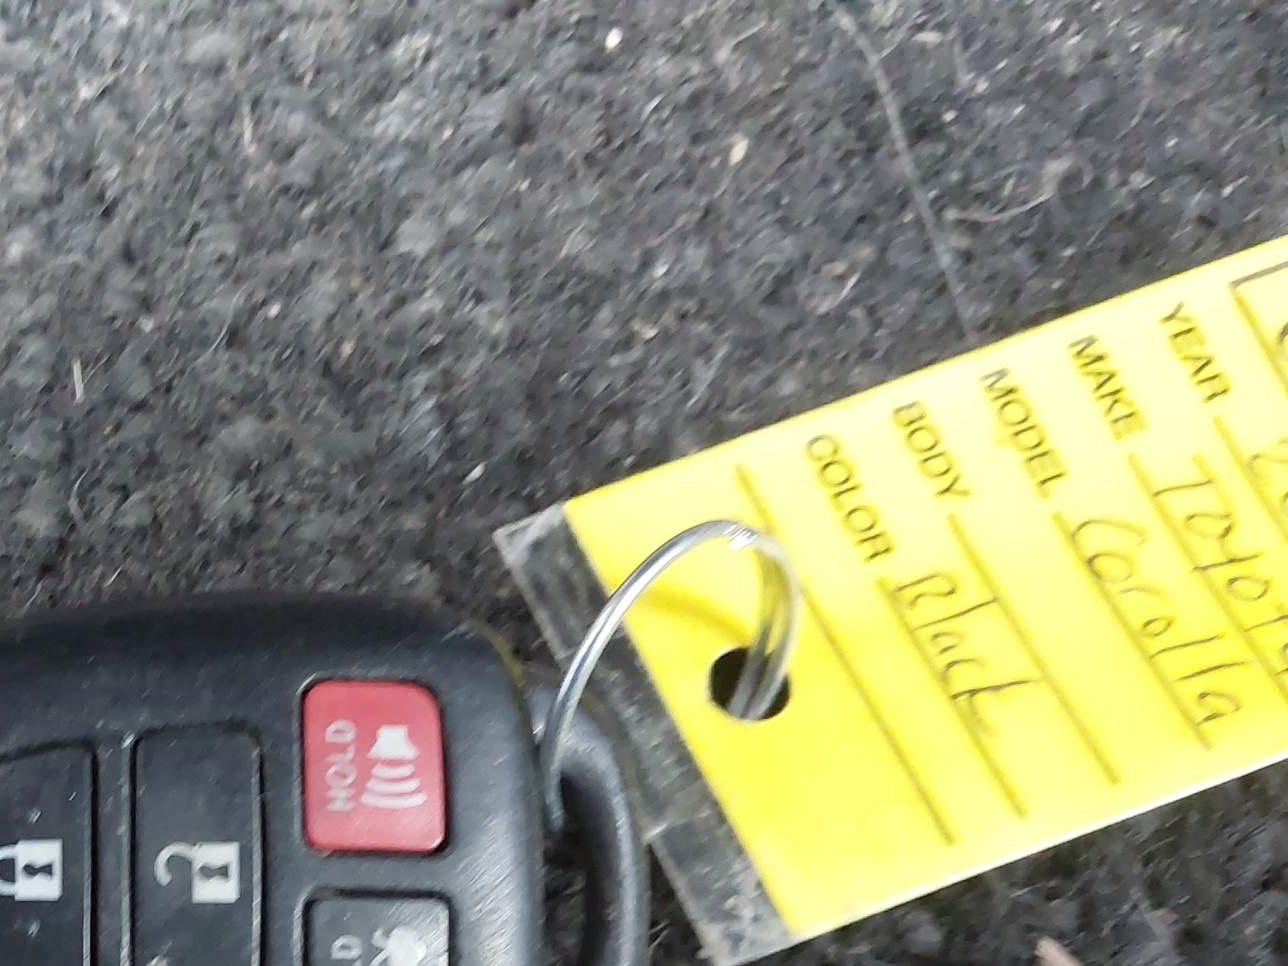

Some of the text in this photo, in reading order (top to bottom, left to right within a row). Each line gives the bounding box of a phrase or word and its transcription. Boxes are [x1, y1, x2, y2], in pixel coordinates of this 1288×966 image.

[1067, 334, 1149, 441] MAKE
[1158, 301, 1231, 405] YEAR
[890, 400, 972, 500] BODY
[978, 366, 1068, 497] MODEL
[804, 432, 896, 563] COLOR
[1069, 517, 1256, 728] Corolla
[325, 718, 357, 813] HOLD
